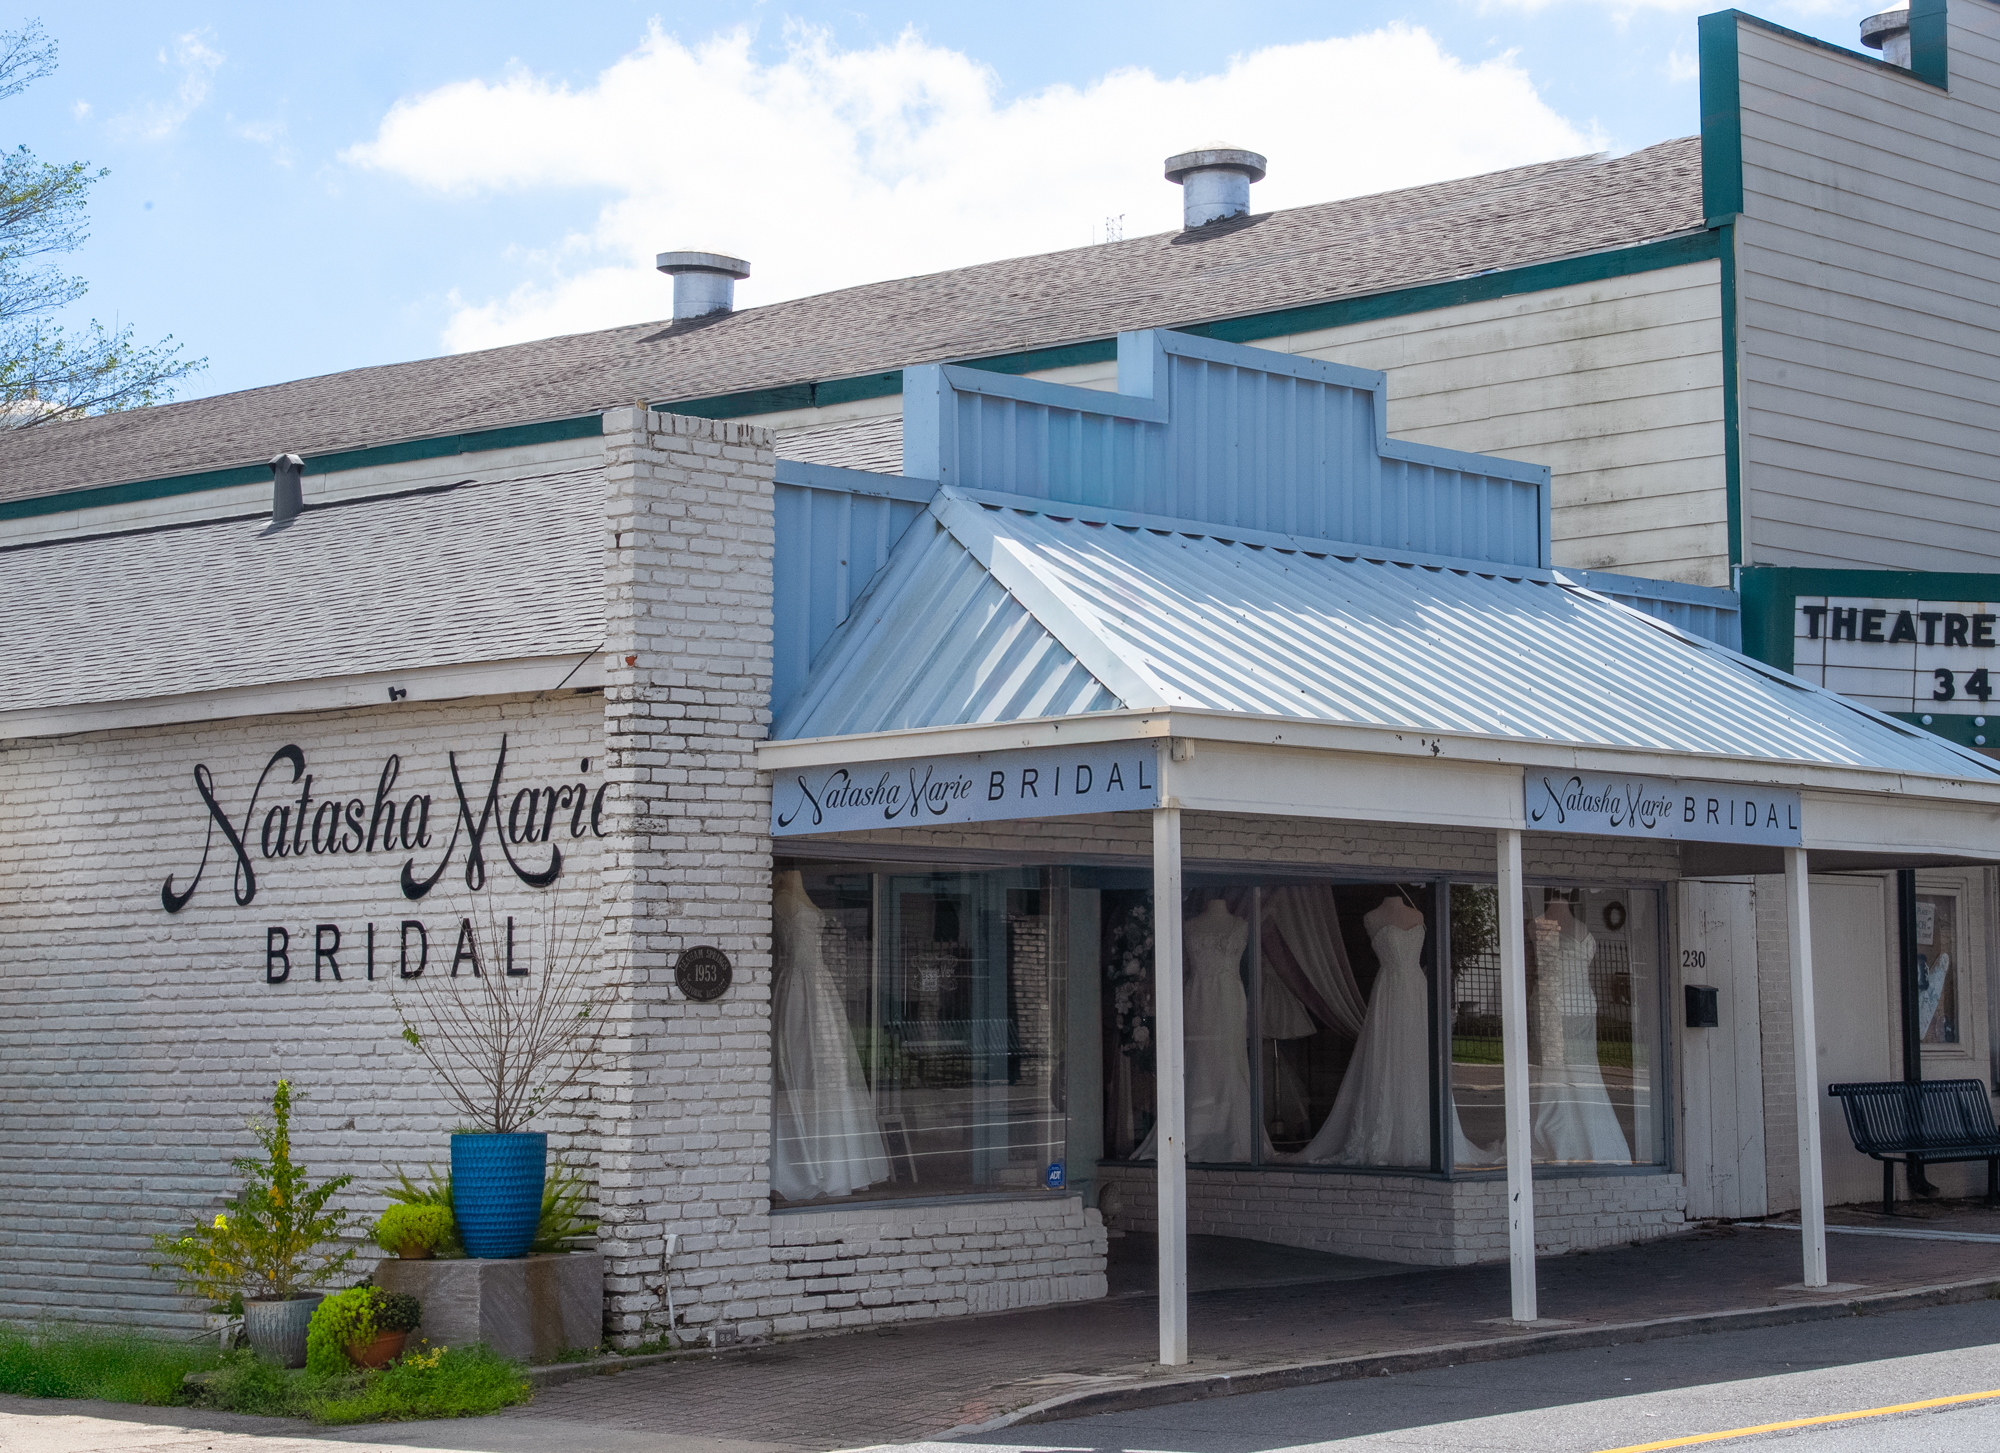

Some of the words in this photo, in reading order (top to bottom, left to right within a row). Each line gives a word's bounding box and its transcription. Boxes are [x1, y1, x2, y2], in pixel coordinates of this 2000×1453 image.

[1803, 605, 1997, 647] THEATRE
[777, 769, 901, 827] Natasha
[884, 765, 973, 820] Marie
[987, 760, 1152, 801] BRIDAL
[1532, 776, 1622, 824] Natasha
[1610, 783, 1673, 829] Marie
[1684, 796, 1798, 830] BRIDAL
[162, 744, 432, 913] Natasha
[266, 916, 529, 984] BRIDAL
[678, 949, 704, 972] DENHAM
[705, 949, 730, 971] SPRINGS
[1682, 949, 1706, 968] 230
[694, 964, 717, 982] 1953
[1049, 1170, 1061, 1180] ADT
